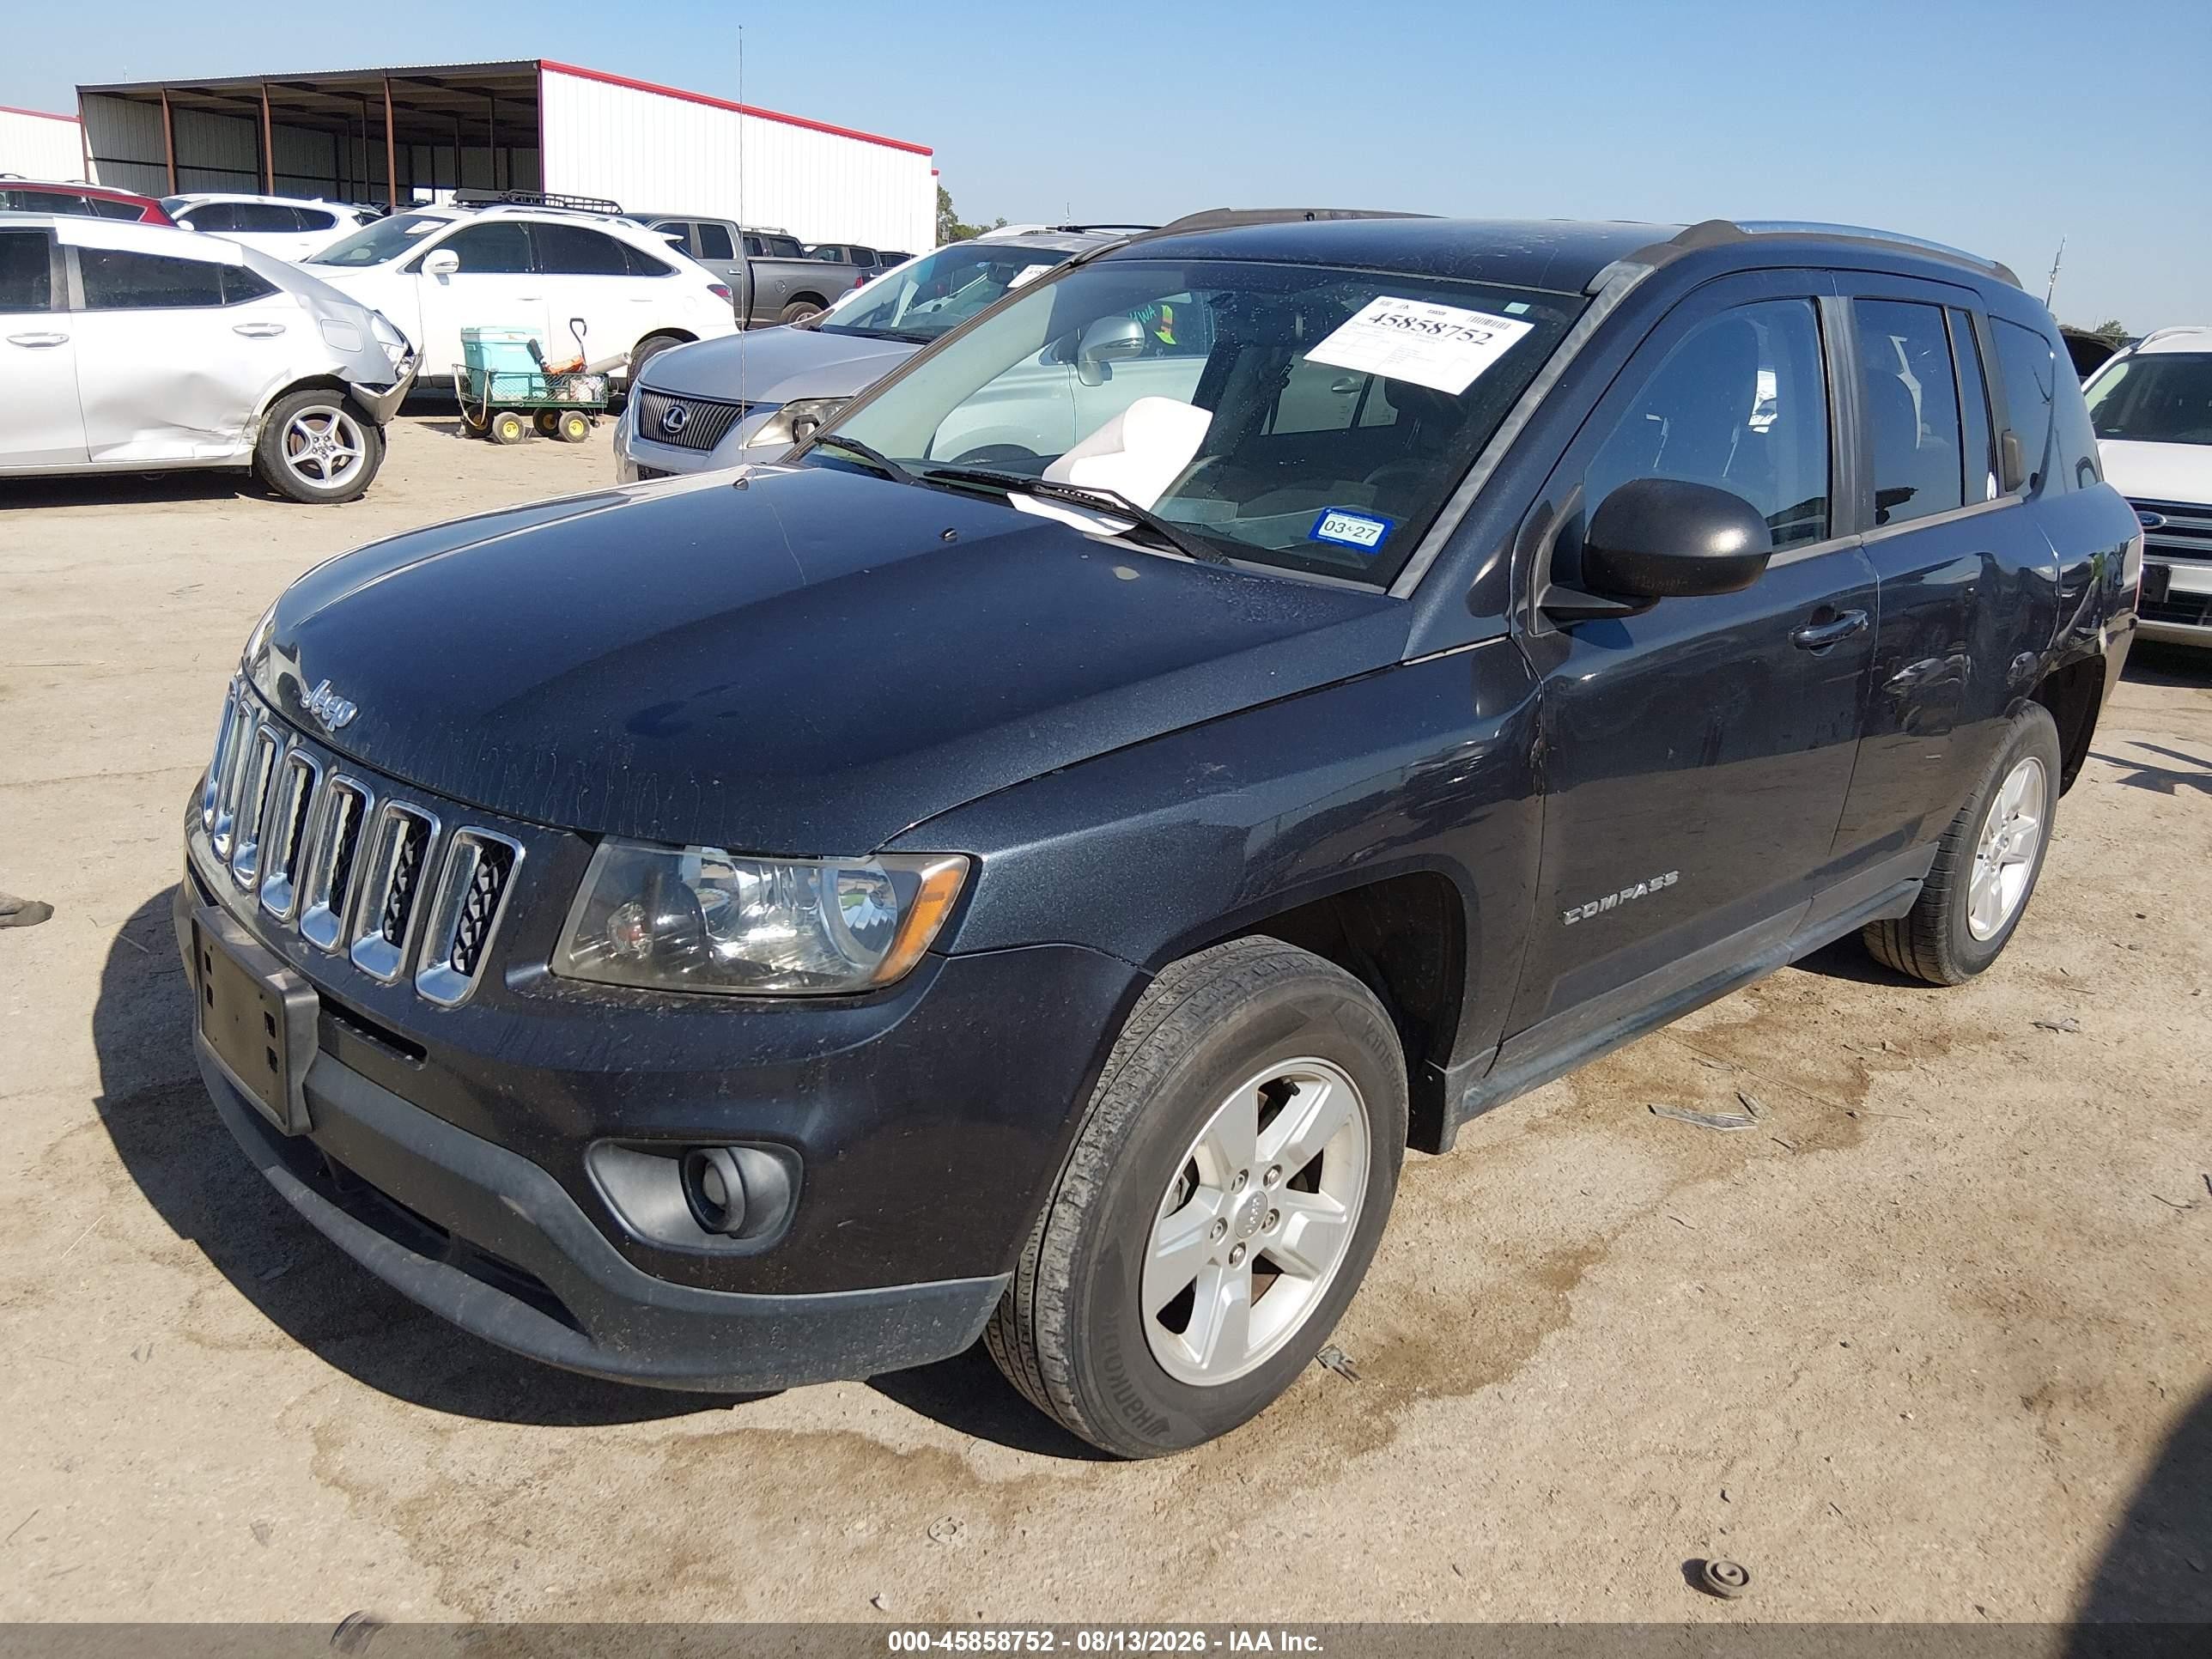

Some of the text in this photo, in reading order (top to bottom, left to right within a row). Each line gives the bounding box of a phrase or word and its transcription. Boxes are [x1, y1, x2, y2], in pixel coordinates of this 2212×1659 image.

[1367, 312, 1494, 345] 45858752
[1324, 520, 1346, 533] 03
[1352, 526, 1379, 539] 27
[300, 678, 358, 732] Jeep
[1563, 870, 1680, 926] COMPASS
